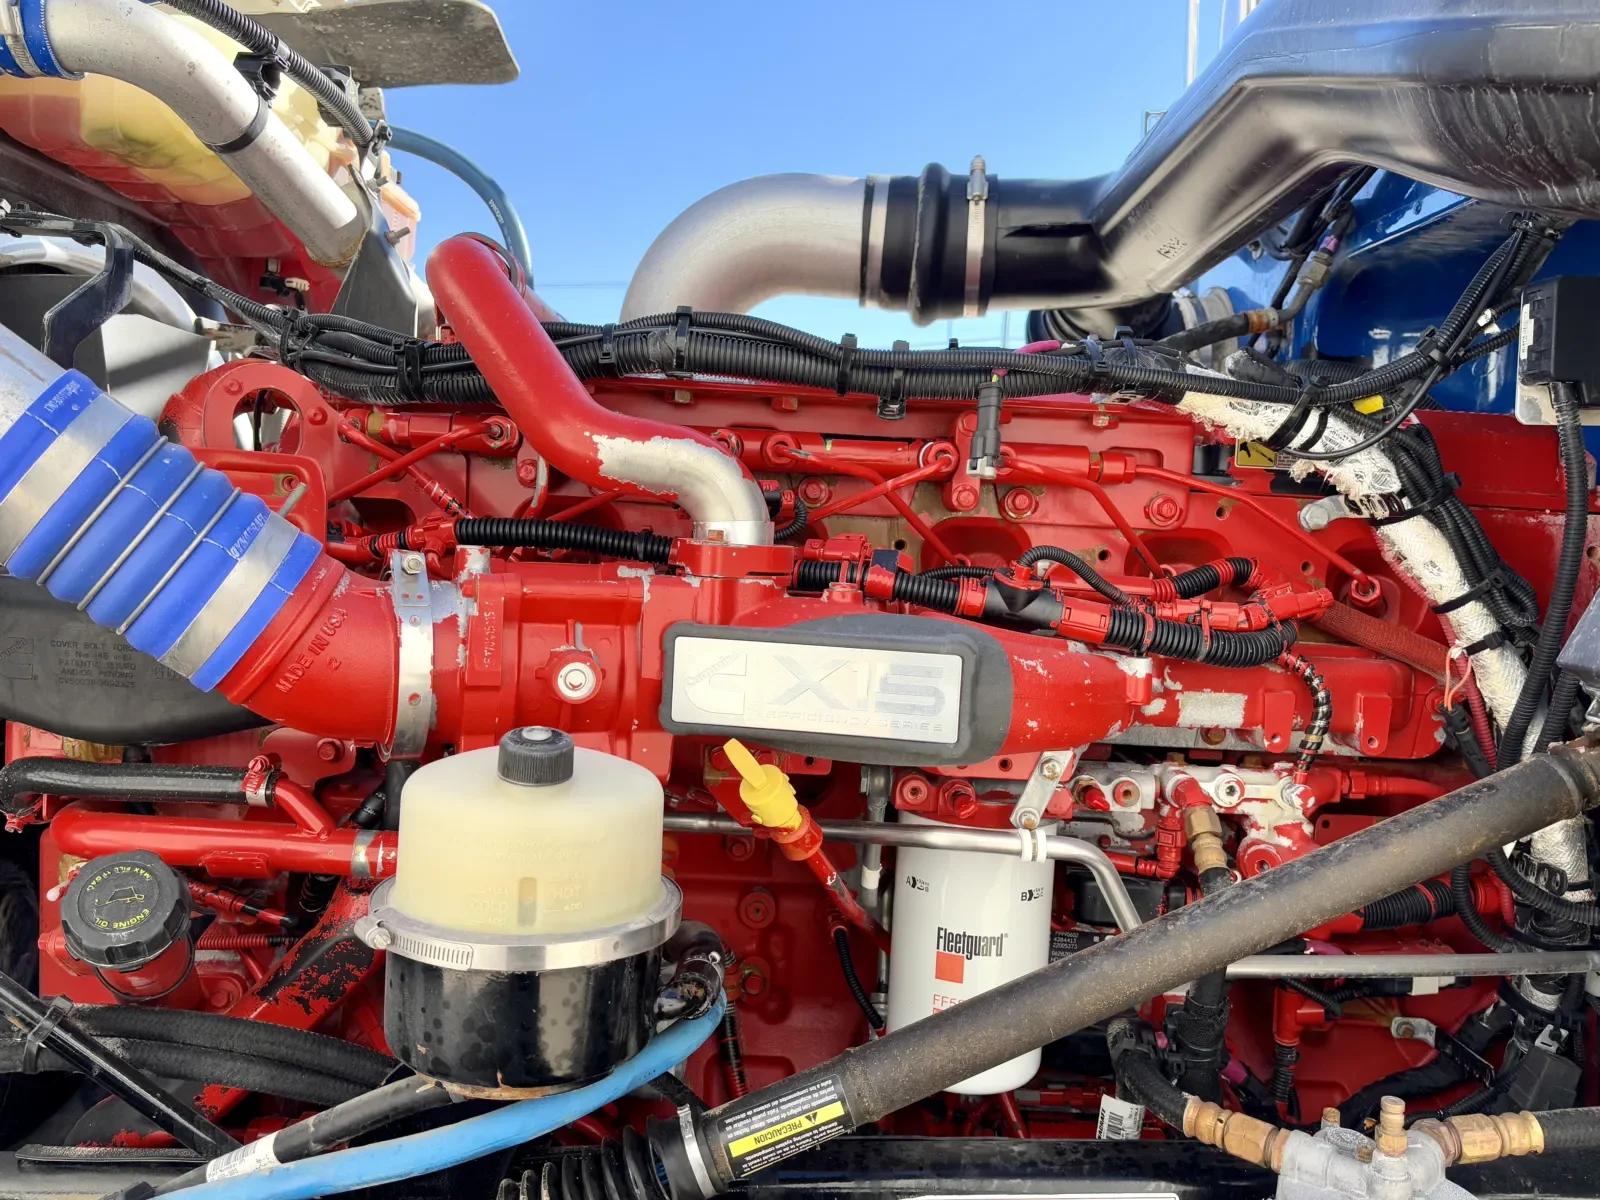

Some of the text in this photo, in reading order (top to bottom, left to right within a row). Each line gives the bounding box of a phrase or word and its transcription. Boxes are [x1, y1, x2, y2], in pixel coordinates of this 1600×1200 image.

[275, 654, 314, 694] MADE
[307, 634, 330, 656] IN
[133, 867, 152, 880] MAX
[95, 908, 150, 929] ENGINE OIL
[936, 926, 1004, 960] Fleetguard
[753, 1119, 803, 1145] PRECAUCION
